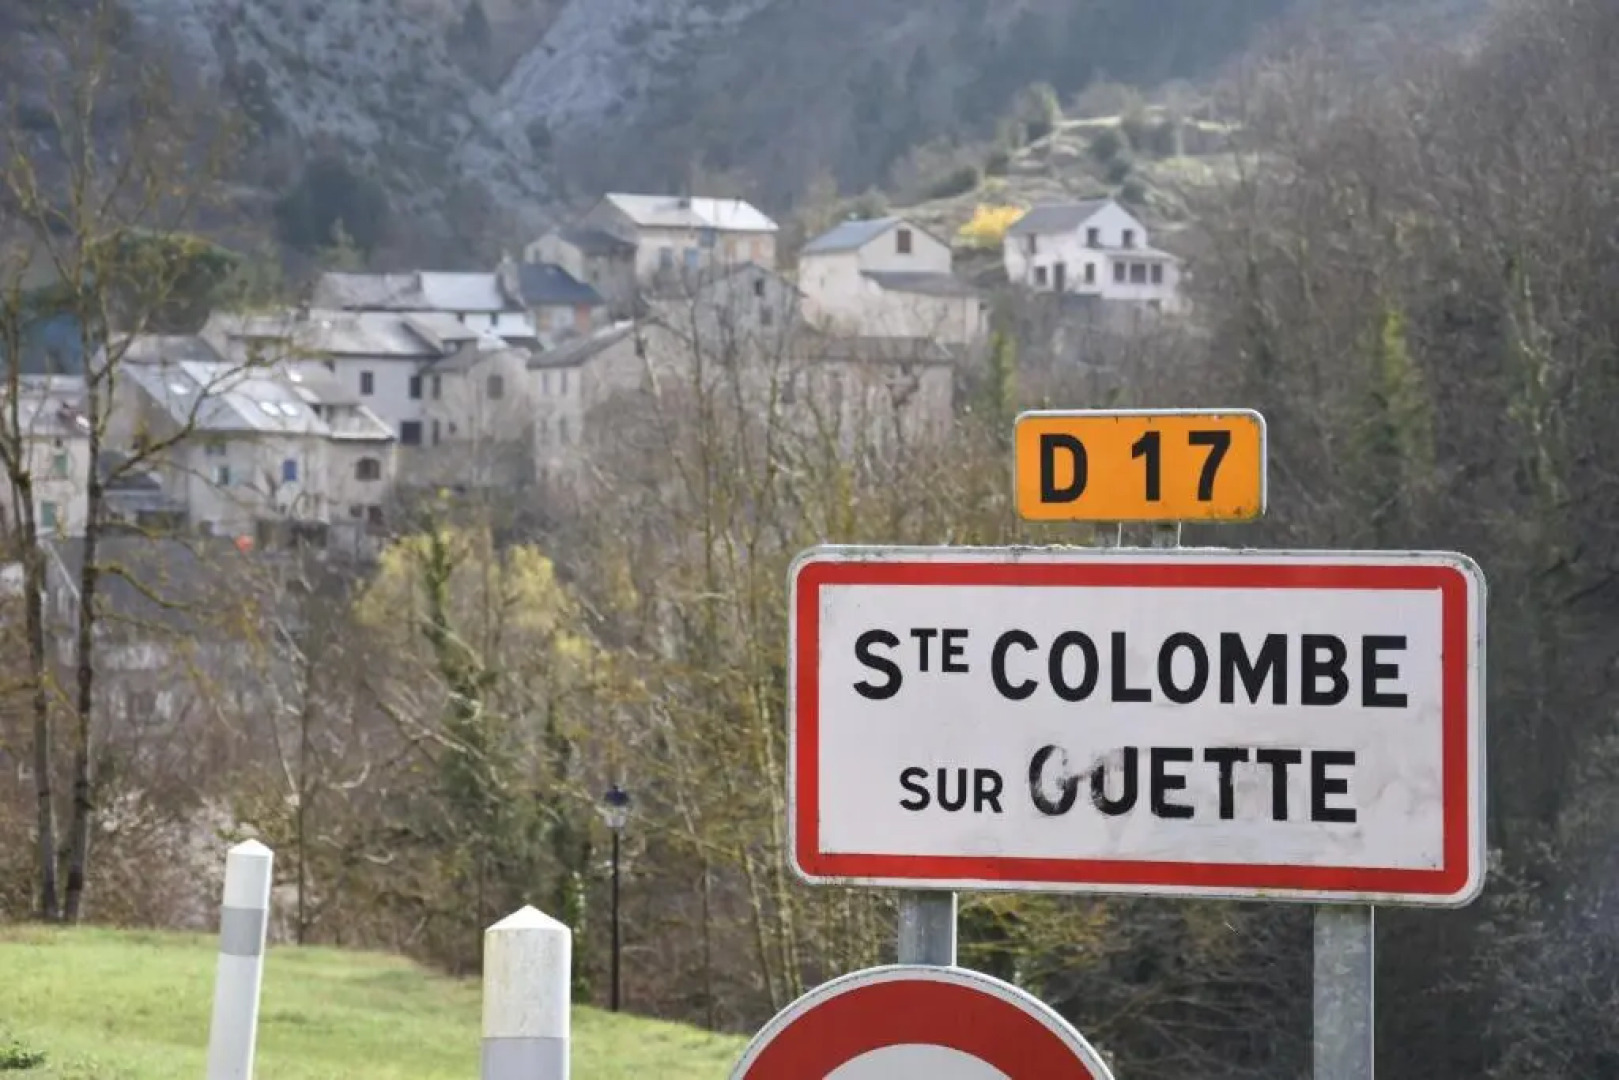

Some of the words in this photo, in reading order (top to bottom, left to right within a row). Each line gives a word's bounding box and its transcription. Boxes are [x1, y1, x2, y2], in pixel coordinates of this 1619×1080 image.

[1039, 433, 1088, 504] D
[1131, 429, 1232, 502] 17
[991, 629, 1408, 708] COLOMBE
[899, 766, 1004, 814] SUR
